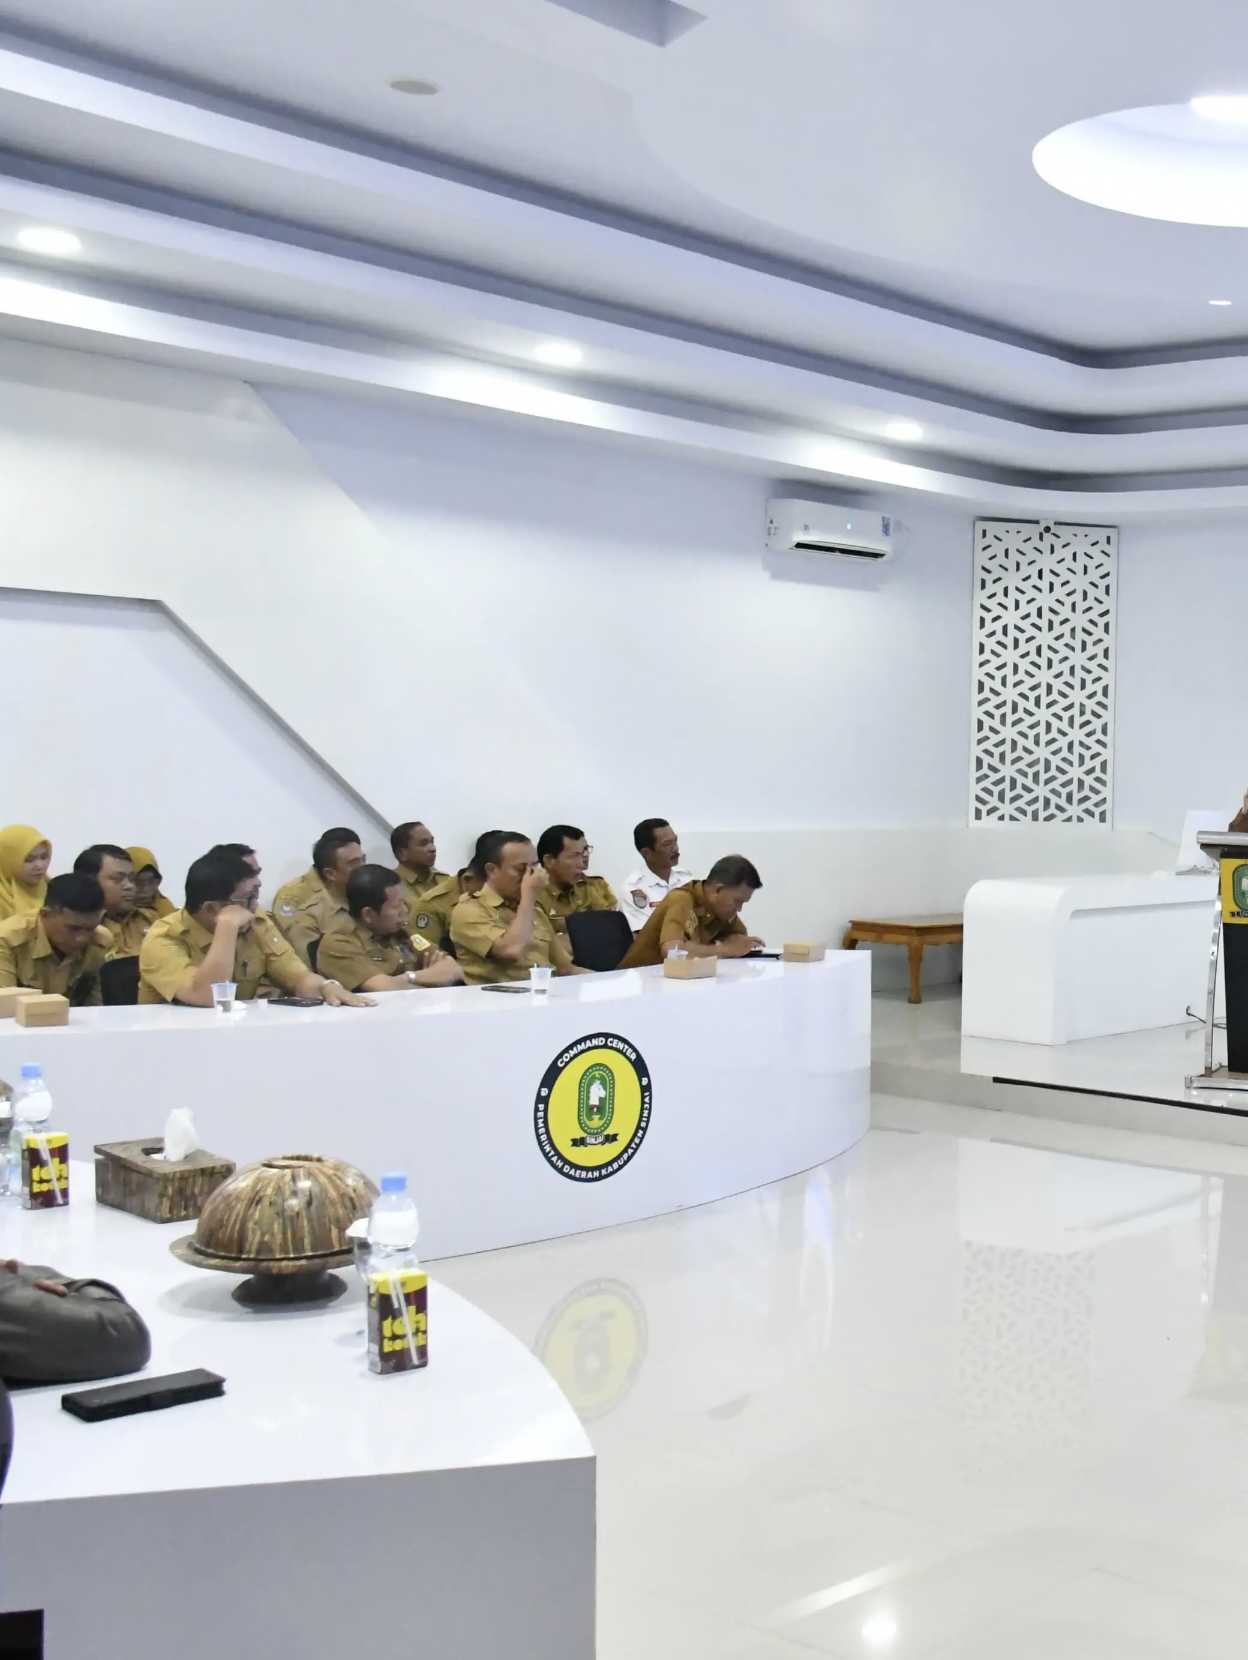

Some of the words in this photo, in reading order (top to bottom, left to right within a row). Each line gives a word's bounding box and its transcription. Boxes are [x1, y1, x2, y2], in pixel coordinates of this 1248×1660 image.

[557, 1037, 605, 1067] COMMAND
[606, 1037, 637, 1062] CENTER
[537, 1104, 563, 1169] PEMERINTAH
[563, 1165, 600, 1179] DAERAH
[601, 1129, 643, 1176] KABUPATEN
[640, 1092, 650, 1128] SINJAI
